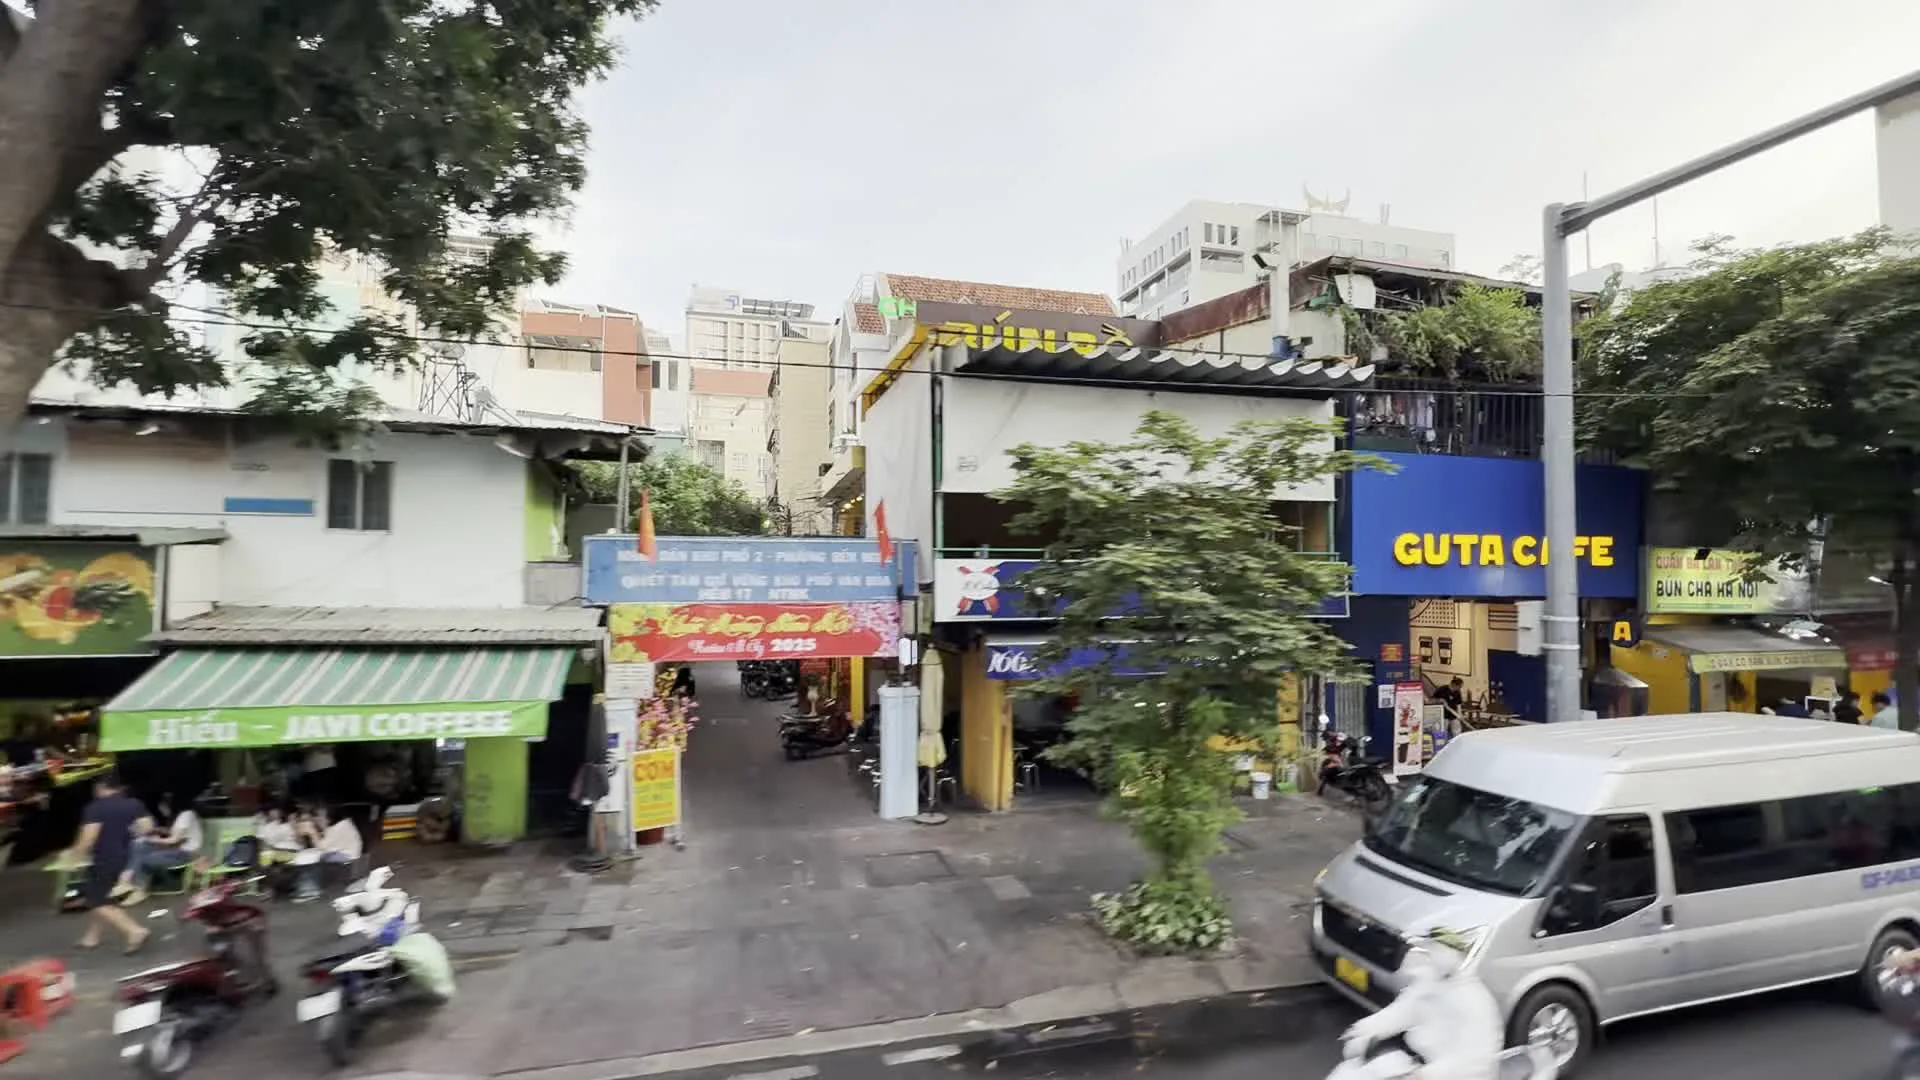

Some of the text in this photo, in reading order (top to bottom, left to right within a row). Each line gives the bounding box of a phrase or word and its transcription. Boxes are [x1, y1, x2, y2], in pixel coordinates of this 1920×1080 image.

[752, 550, 764, 562] 2
[1393, 532, 1505, 567] GUTA
[1614, 620, 1633, 641] A
[769, 637, 818, 652] 2025
[145, 708, 240, 745] Hiếu
[278, 713, 362, 744] JAVI
